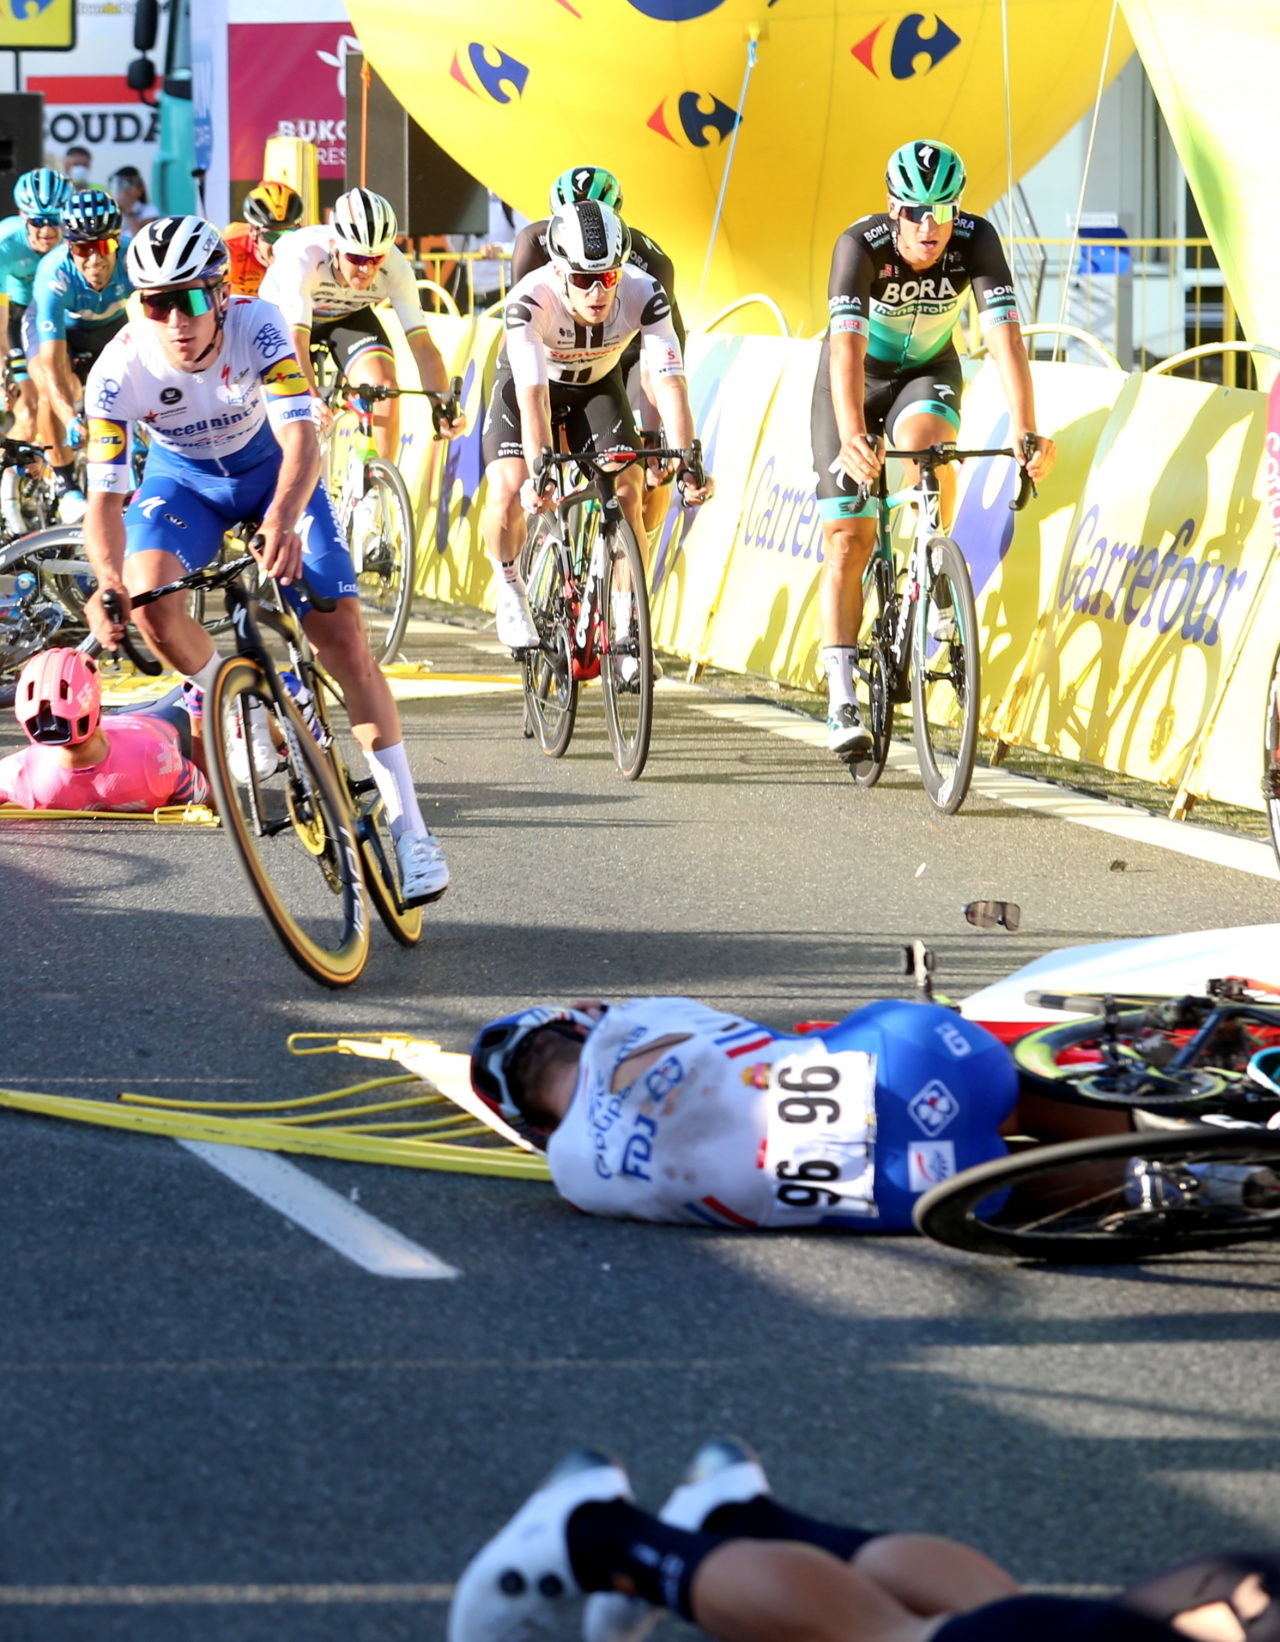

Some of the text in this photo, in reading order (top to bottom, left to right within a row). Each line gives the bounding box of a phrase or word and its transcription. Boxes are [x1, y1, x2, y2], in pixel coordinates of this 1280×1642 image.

[863, 223, 889, 242] BORA
[629, 250, 649, 272] ORA
[881, 278, 957, 304] BORA
[1059, 503, 1250, 647] Carrefour
[778, 1065, 841, 1124] 96
[622, 1113, 659, 1182] FDJ
[776, 1159, 840, 1207] 96
